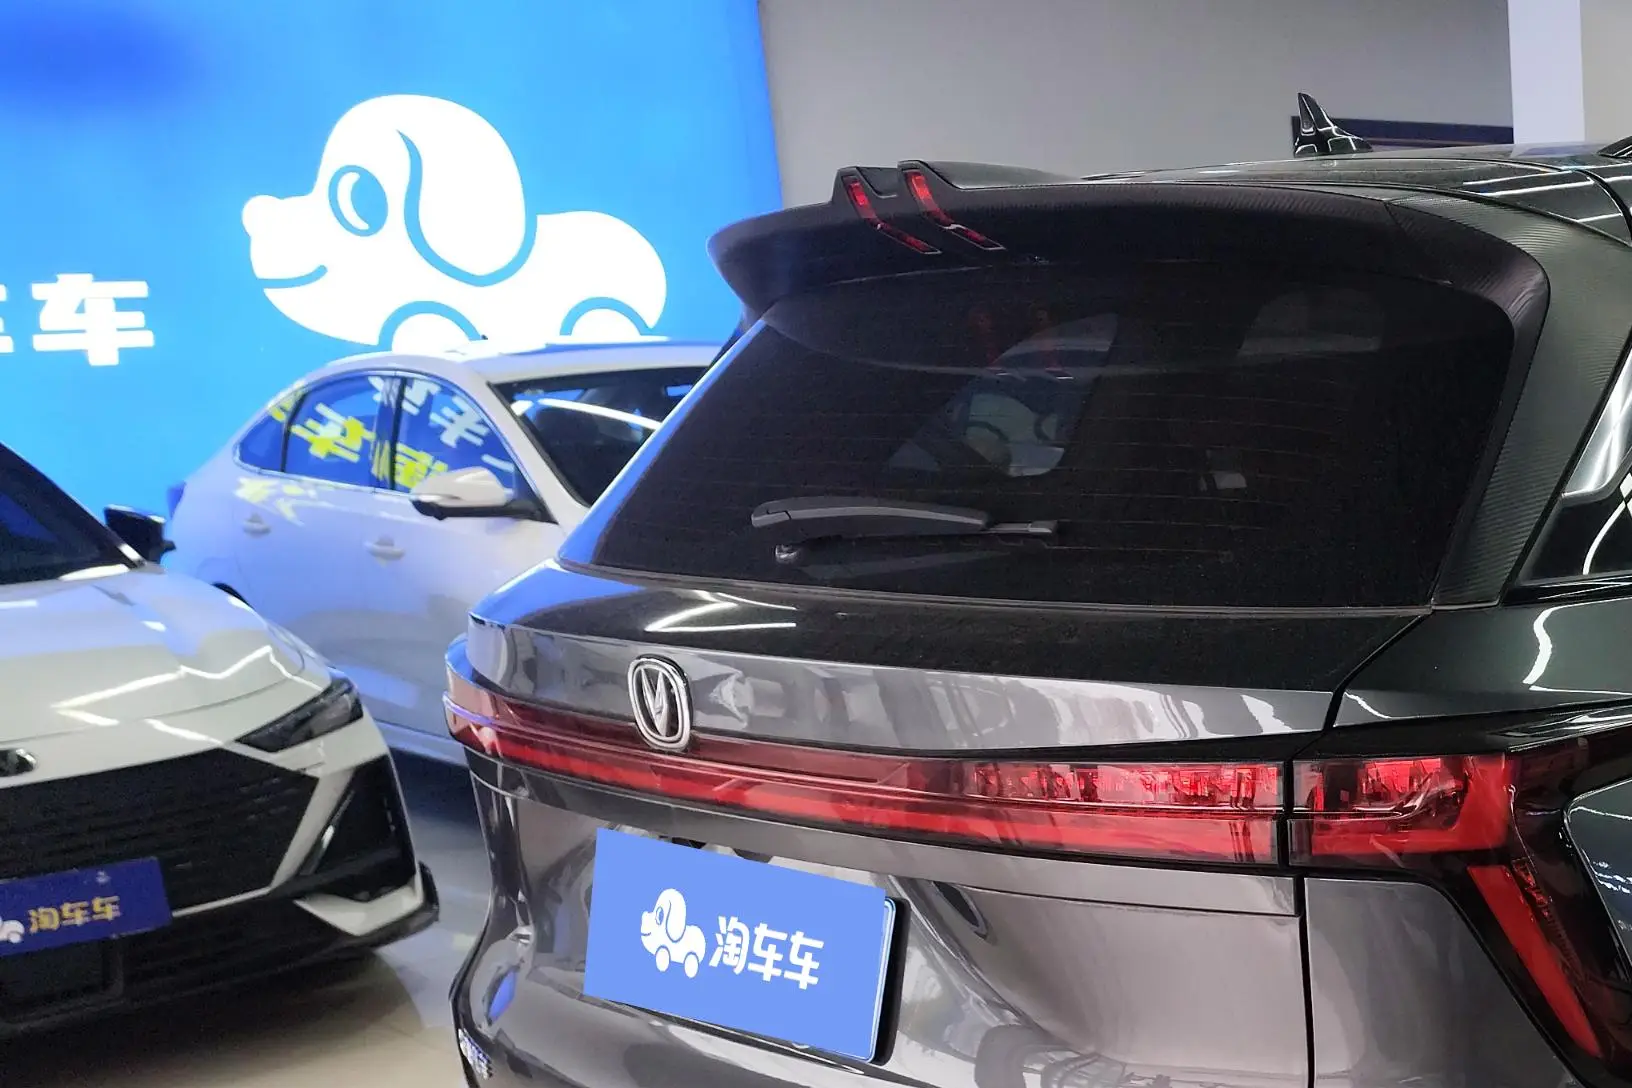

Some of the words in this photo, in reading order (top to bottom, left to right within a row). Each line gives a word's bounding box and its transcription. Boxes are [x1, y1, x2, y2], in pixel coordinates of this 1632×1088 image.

[0, 273, 155, 366] 车
[28, 895, 121, 934] 淘车车
